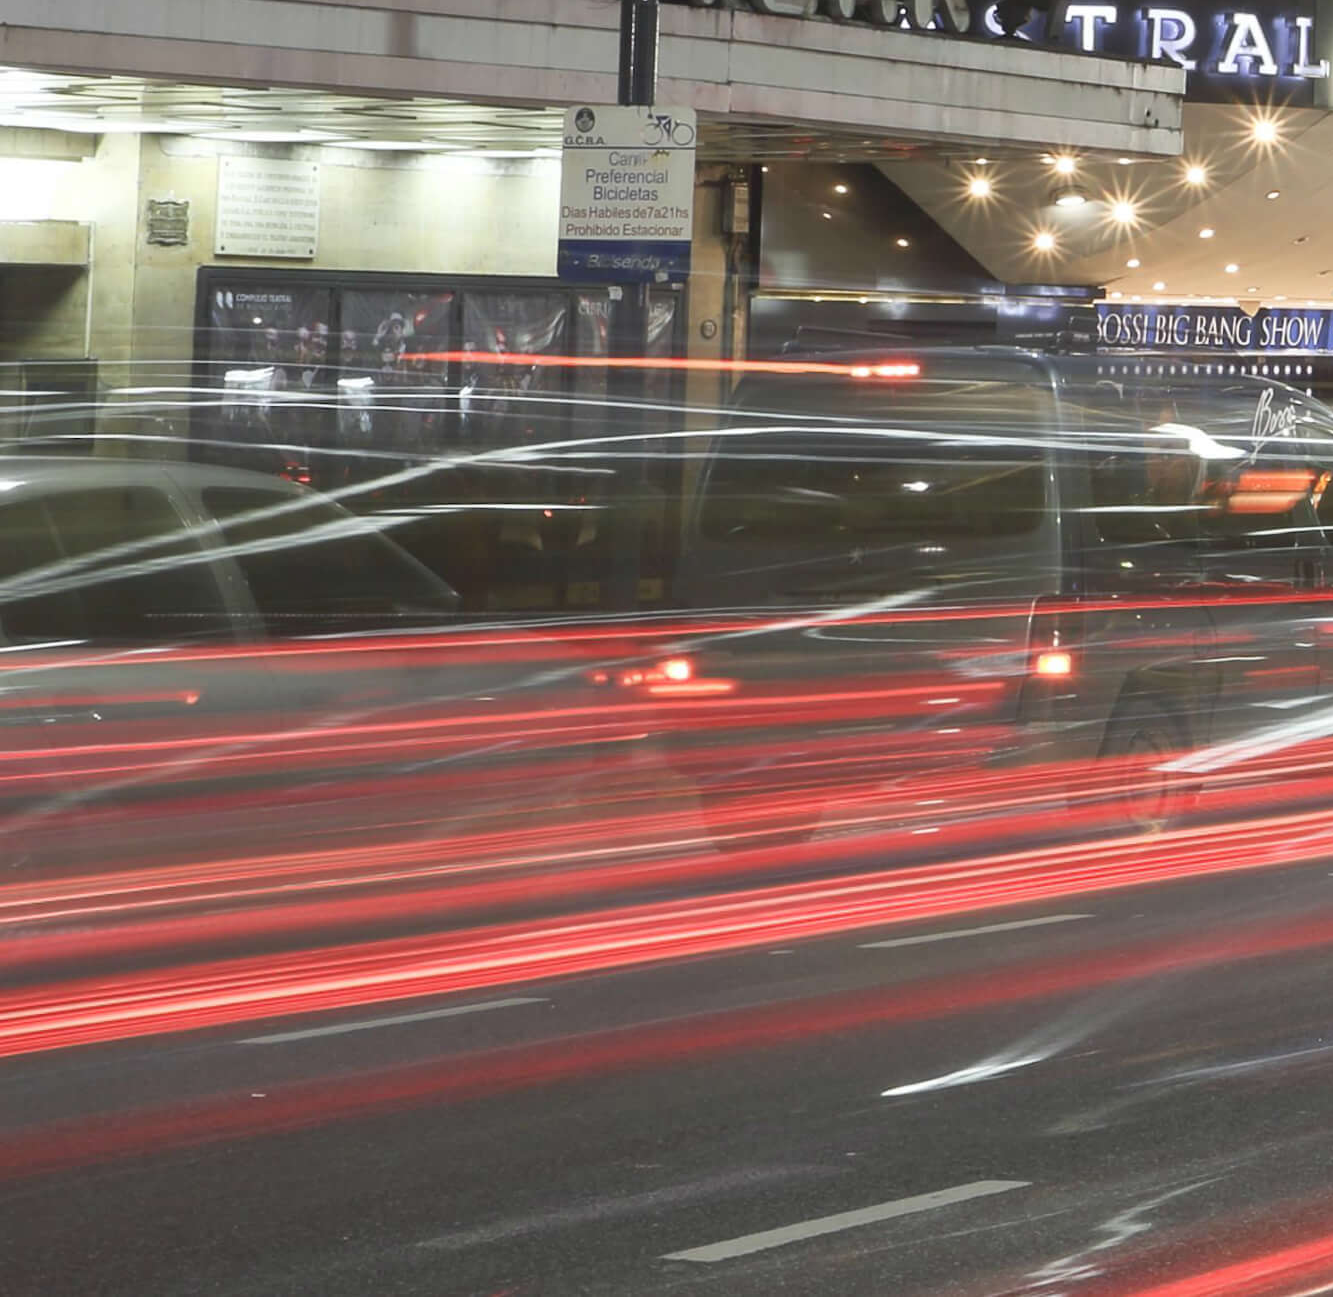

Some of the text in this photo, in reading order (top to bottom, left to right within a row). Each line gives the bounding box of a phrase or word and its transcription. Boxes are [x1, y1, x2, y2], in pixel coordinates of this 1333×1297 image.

[585, 168, 669, 184] Preferencial
[593, 186, 659, 201] Bicicletas
[566, 223, 684, 236] Prohibido Estacionar
[1154, 313, 1191, 346] BIG
[1194, 314, 1253, 347] BANG
[1259, 315, 1324, 347] SHOW
